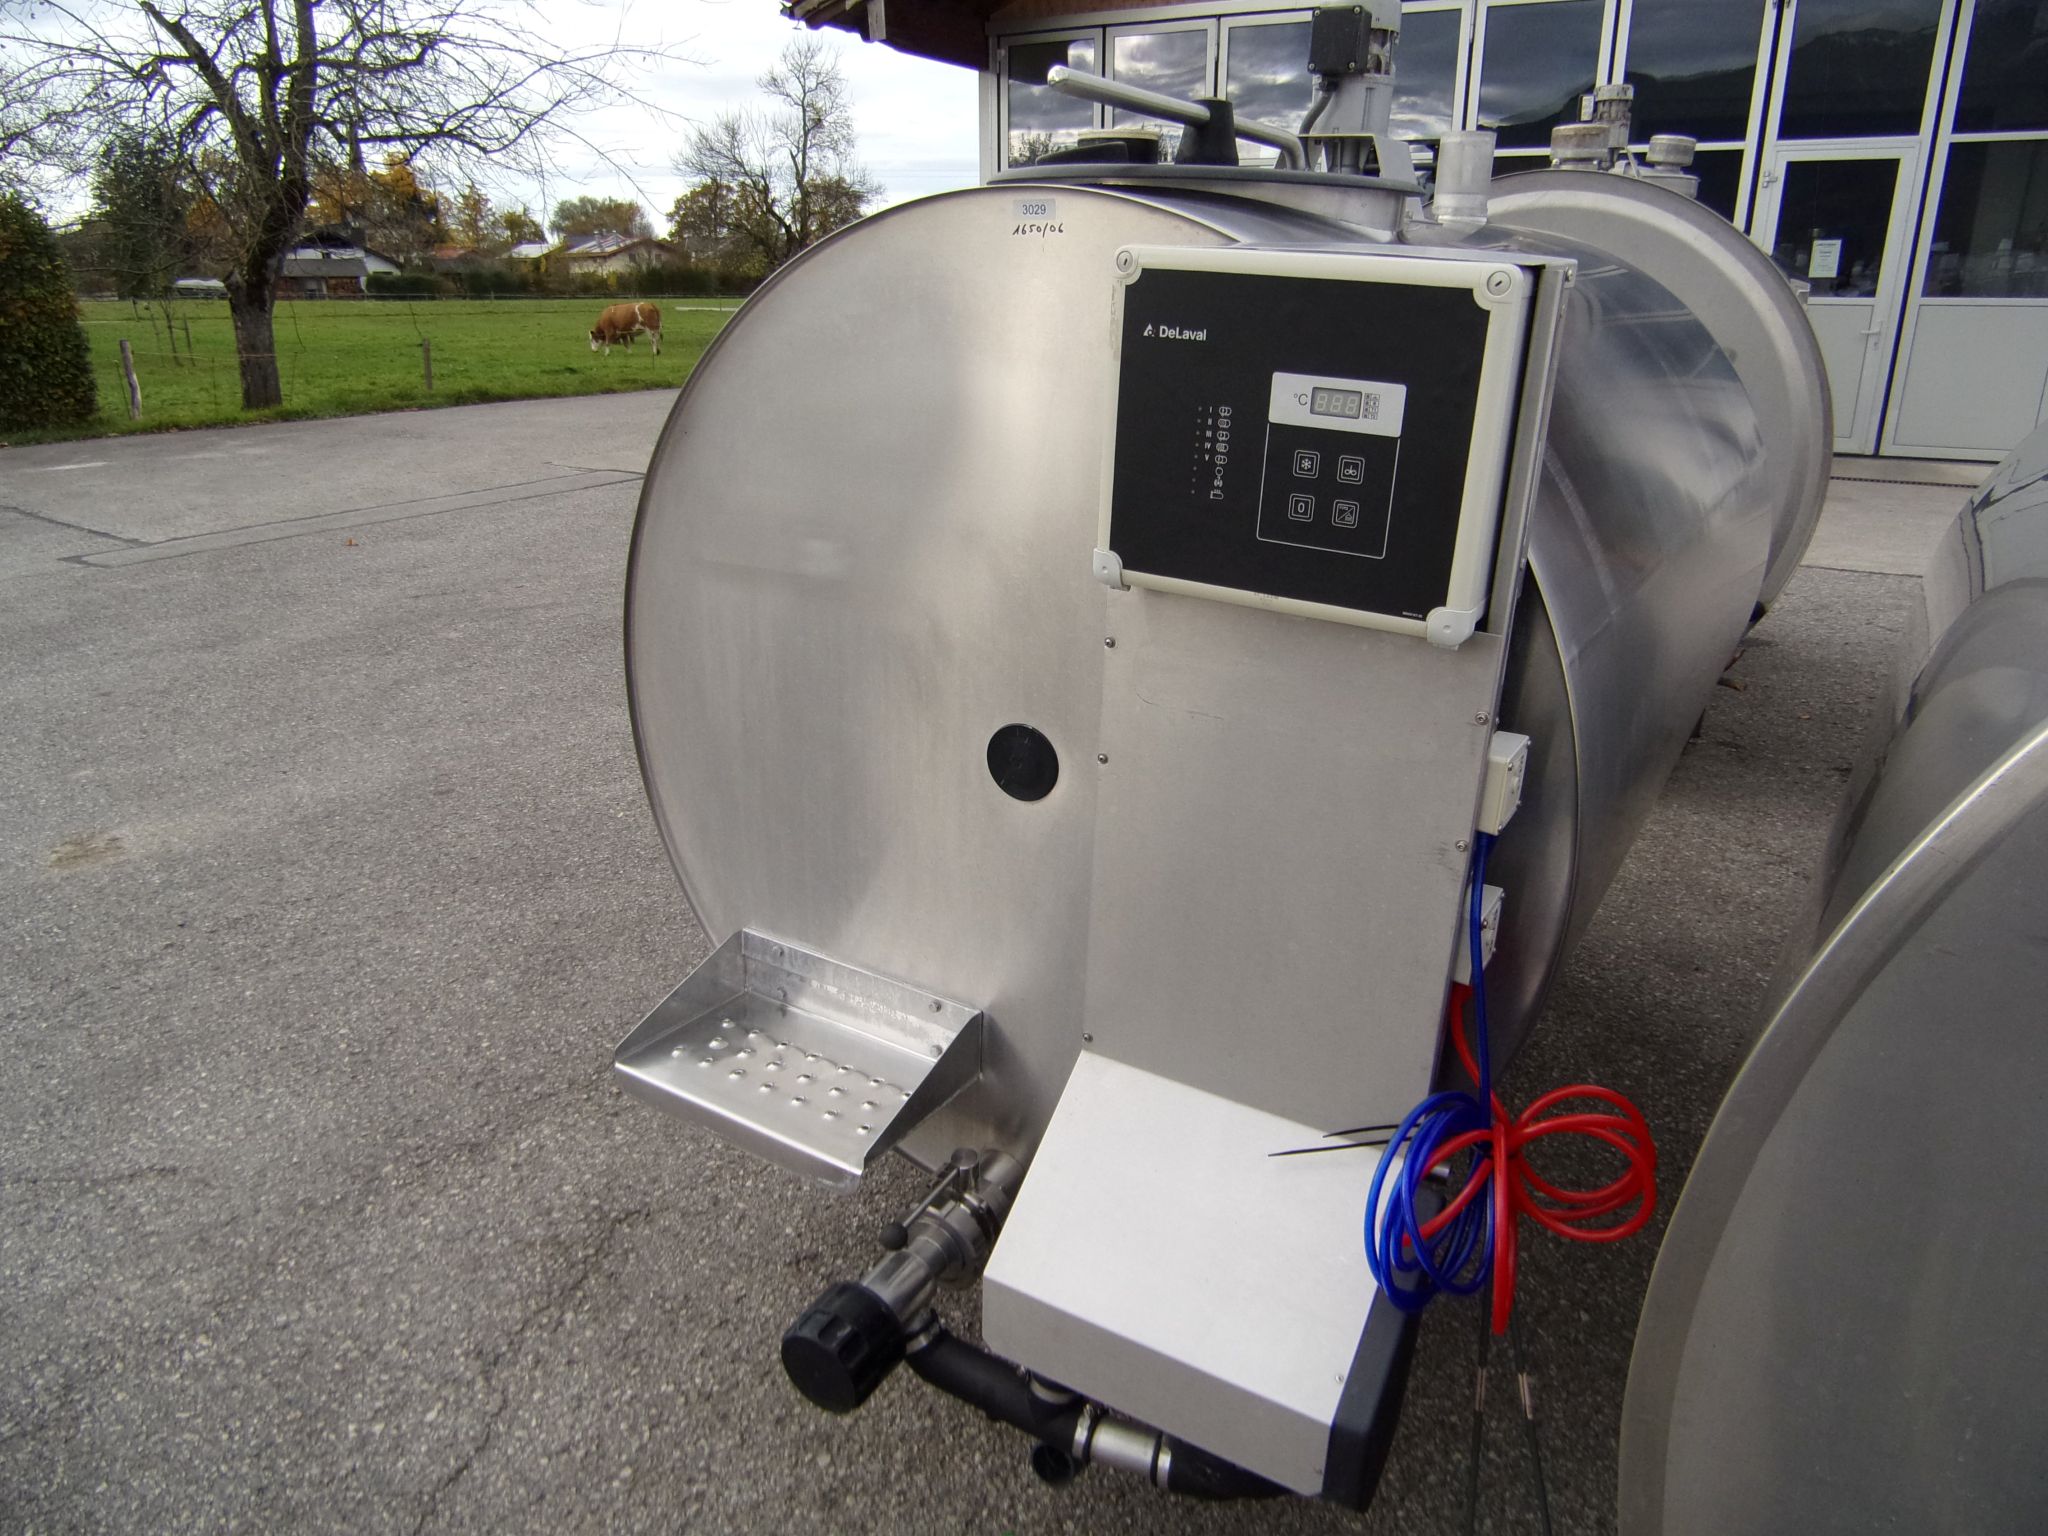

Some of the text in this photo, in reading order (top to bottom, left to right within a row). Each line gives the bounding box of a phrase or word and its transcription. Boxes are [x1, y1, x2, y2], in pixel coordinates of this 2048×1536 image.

[1022, 204, 1046, 215] 3029
[1012, 222, 1064, 238] 1650/06
[1159, 325, 1207, 341] DeLaval
